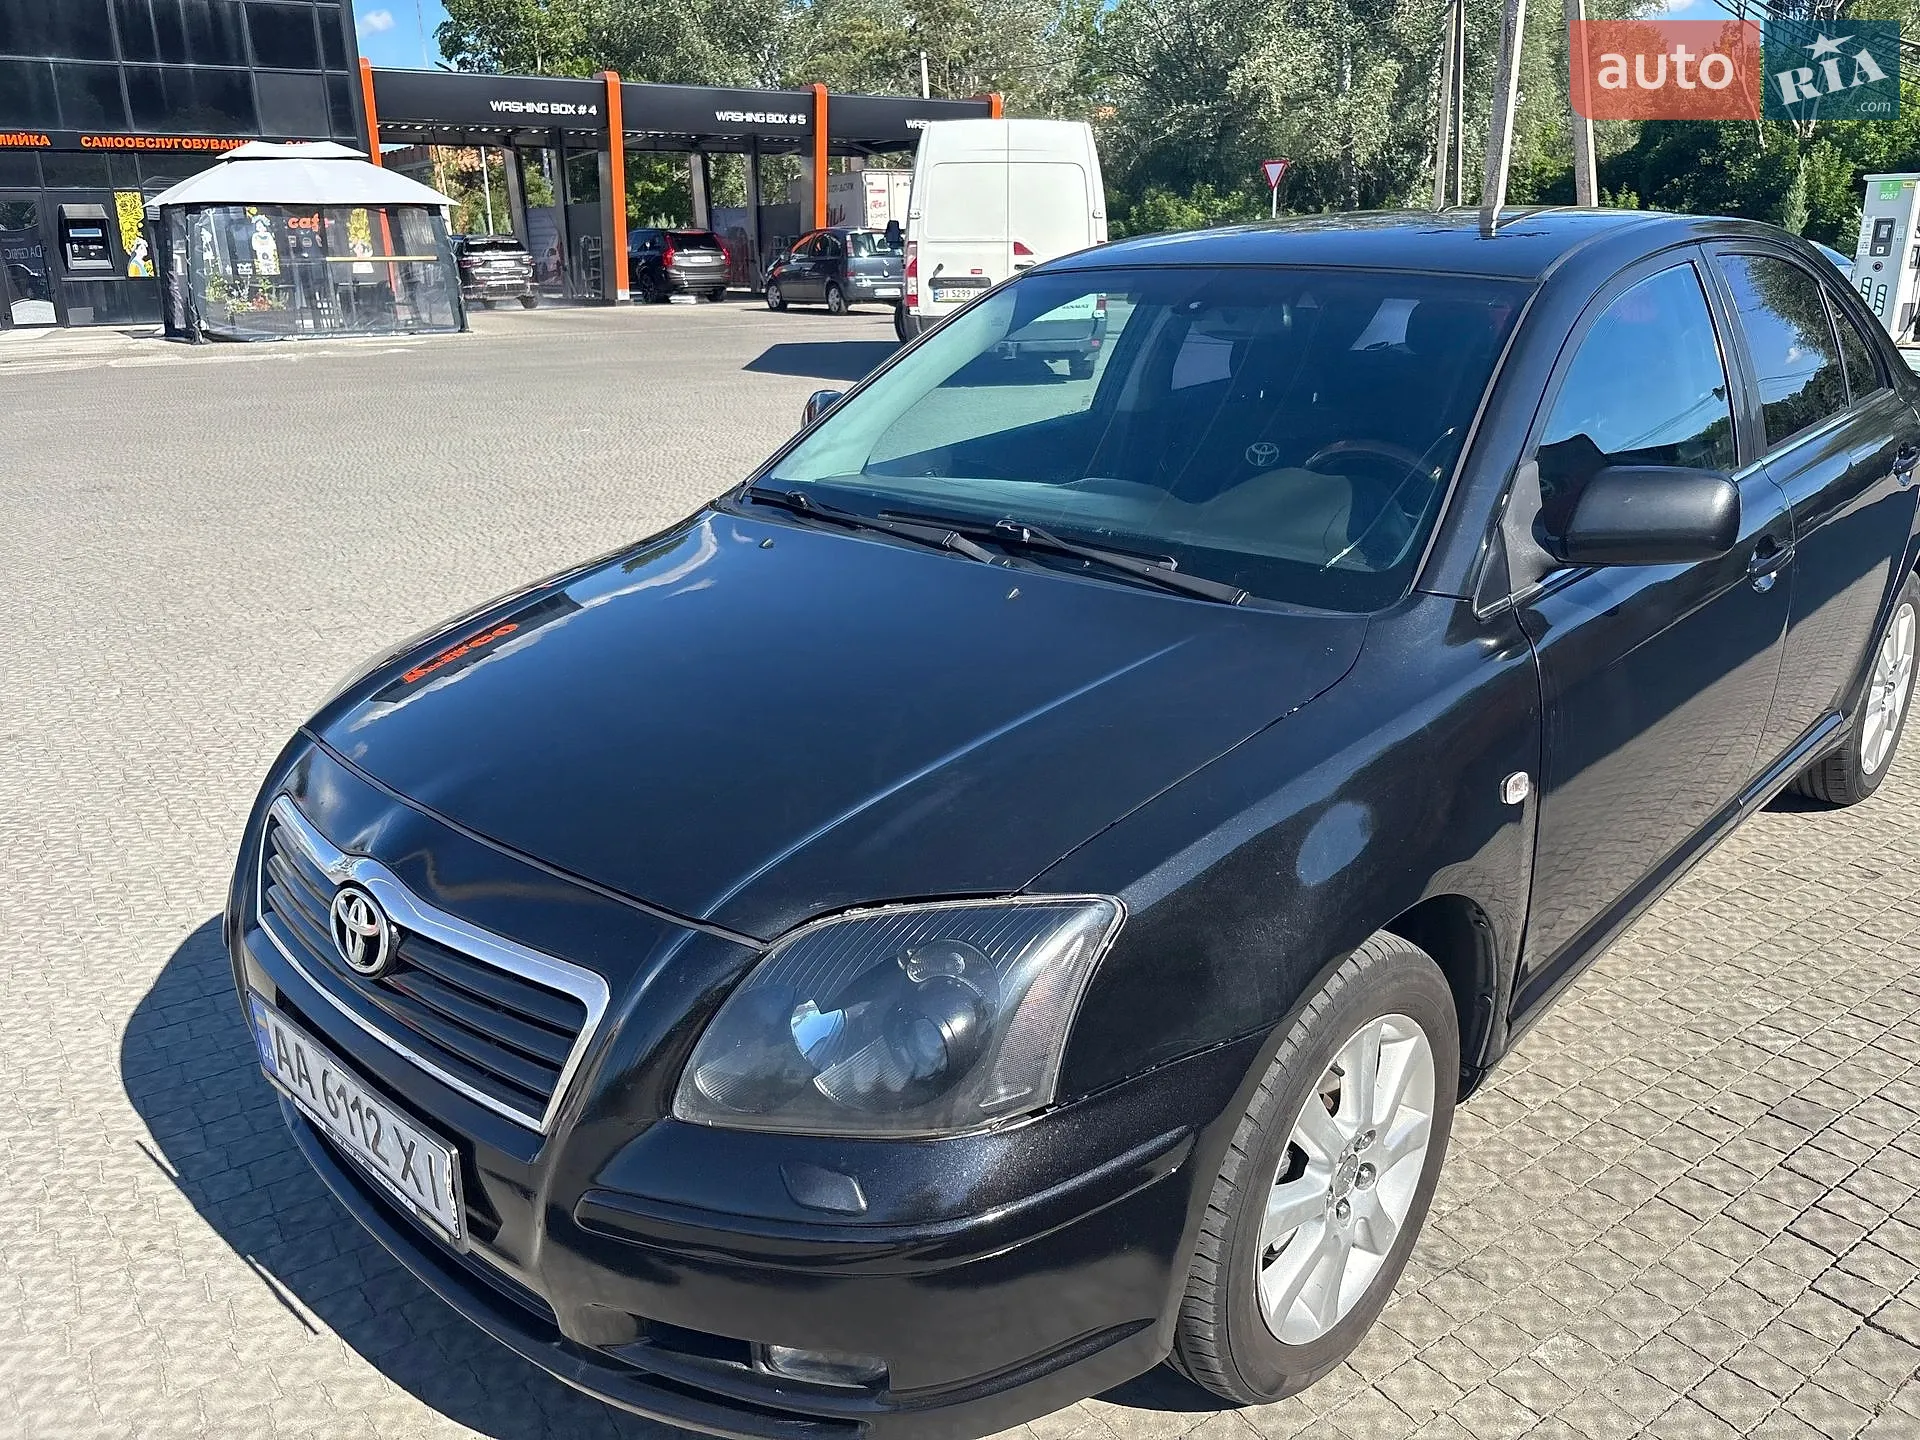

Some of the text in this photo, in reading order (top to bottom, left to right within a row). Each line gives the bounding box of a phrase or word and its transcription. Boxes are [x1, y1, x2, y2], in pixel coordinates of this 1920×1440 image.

[489, 100, 597, 115] WASHING BOX # 4
[715, 111, 765, 124] WASHING
[766, 114, 788, 125] BOX
[80, 136, 257, 150] САМООБСЛУГОВУВАНН
[951, 290, 971, 298] 5299
[274, 1025, 317, 1101] AA
[321, 1068, 390, 1168] 6112
[393, 1126, 441, 1211] XI
